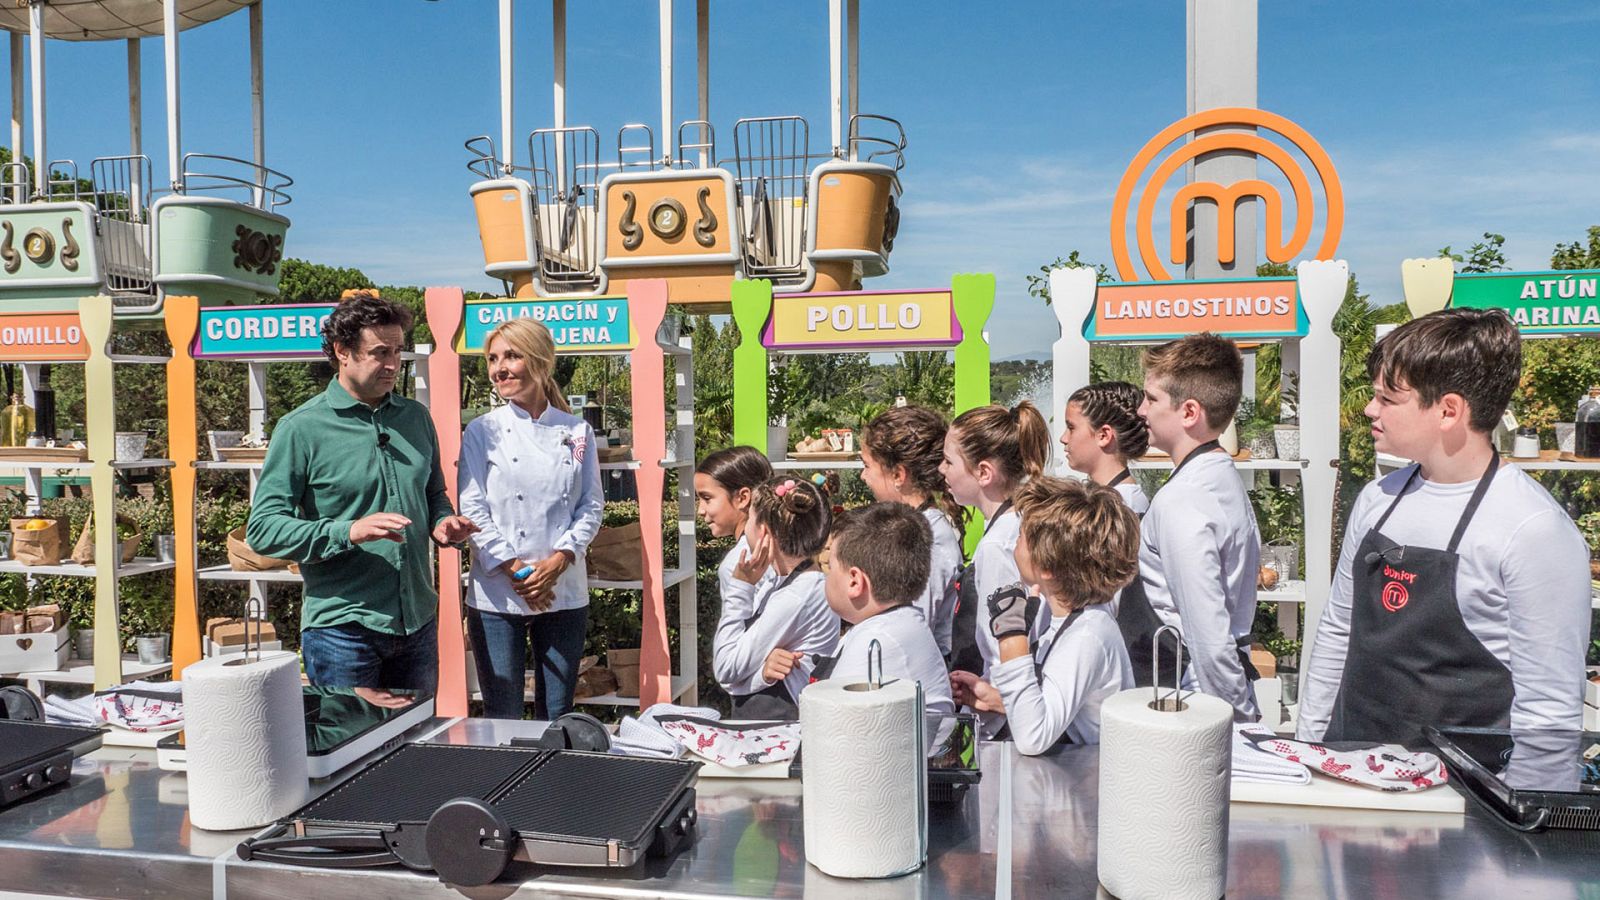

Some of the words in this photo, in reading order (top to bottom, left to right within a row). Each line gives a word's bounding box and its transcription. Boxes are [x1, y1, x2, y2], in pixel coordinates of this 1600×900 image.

[662, 210, 673, 225] 2
[33, 237, 41, 251] 2
[1520, 275, 1597, 300] ATÚN
[478, 301, 598, 324] CALABACÍN
[807, 303, 922, 331] POLLO
[1104, 296, 1290, 319] LANGOSTINOS
[1507, 305, 1600, 326] ARINA
[0, 325, 80, 346] OMILLO
